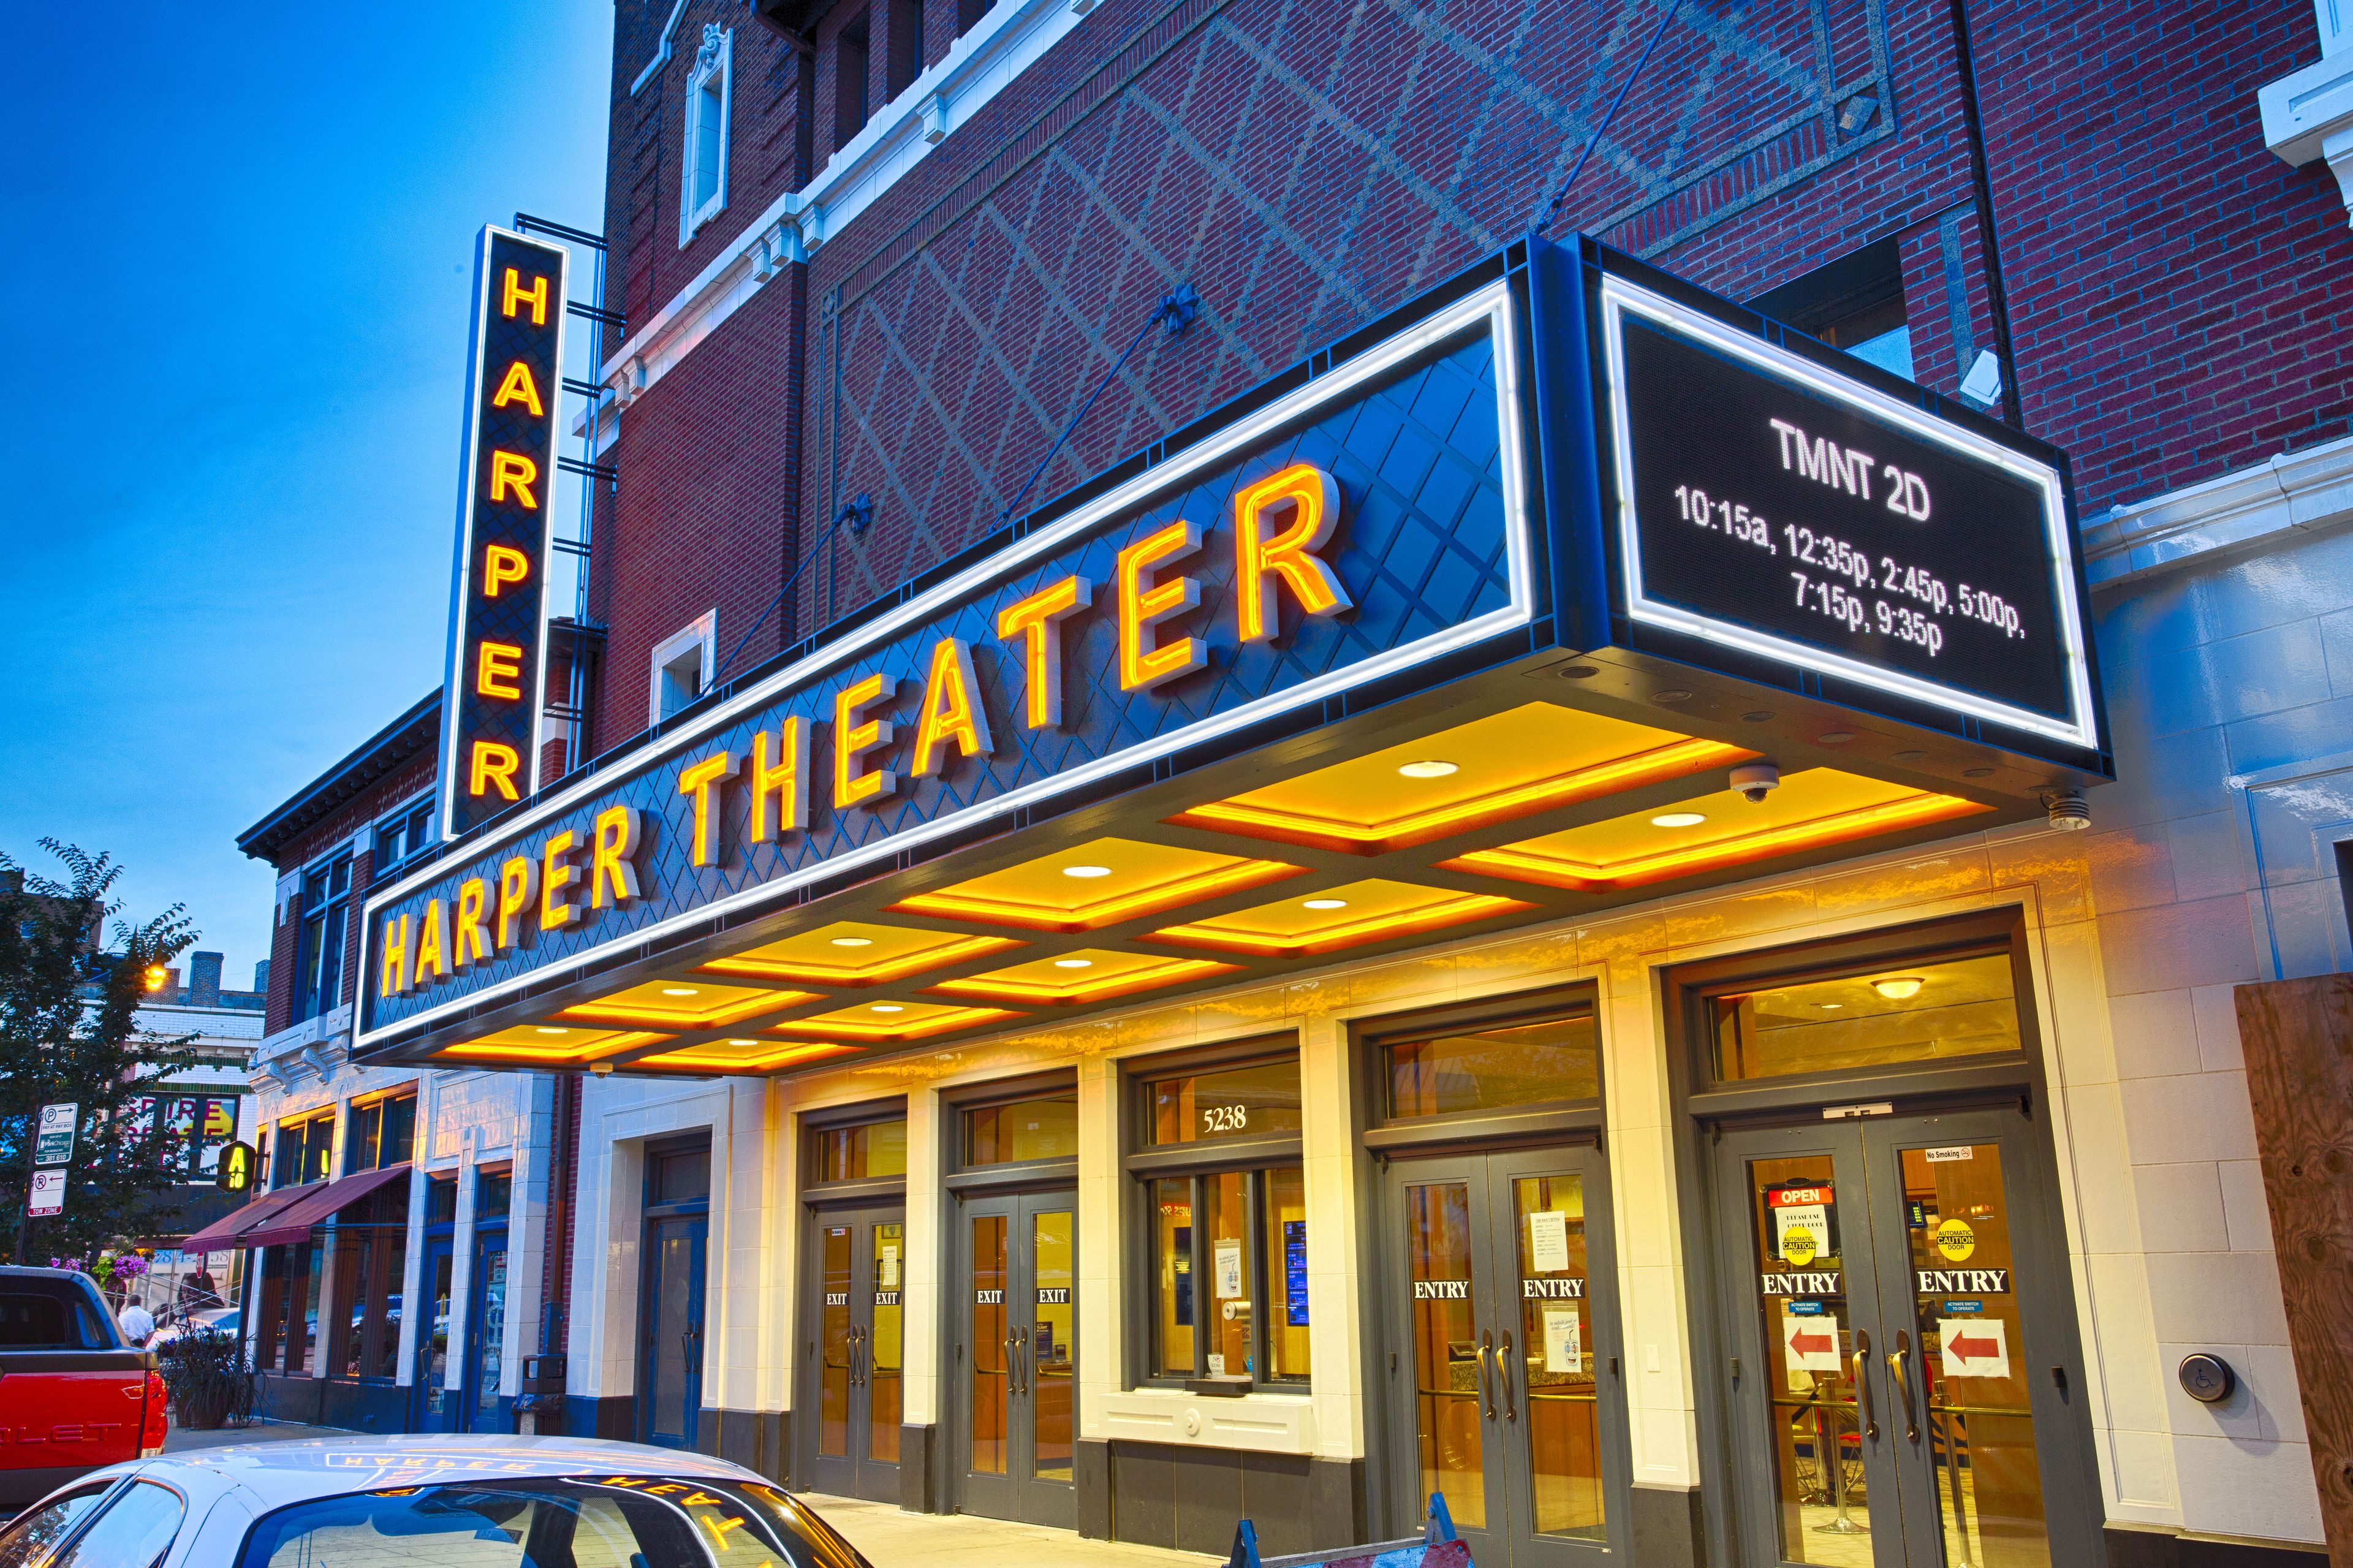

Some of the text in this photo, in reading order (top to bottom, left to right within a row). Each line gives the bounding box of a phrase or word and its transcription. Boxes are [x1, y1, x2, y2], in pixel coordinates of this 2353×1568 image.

[1770, 418, 1931, 522] TMNT 2D
[469, 267, 547, 801] HARPER
[1675, 485, 2026, 639] 10:15a, 12:35p, 2:45p, 5:00p,
[1791, 572, 1943, 657] 7:15p, 9:35p
[382, 805, 640, 998] HARPER
[679, 464, 1354, 868] THEATER
[1204, 1105, 1246, 1133] 5238
[229, 1148, 244, 1172] A
[1927, 1150, 1960, 1160] No Smoking
[1781, 1189, 1820, 1203] OPEN
[1414, 1281, 1469, 1298] ENTRY
[1523, 1279, 1584, 1298] ENTRY
[1762, 1273, 1839, 1294] ENTRY
[1917, 1270, 2006, 1292] ENTRY
[827, 1293, 847, 1305] EXIT
[876, 1292, 897, 1305] EXIT
[977, 1290, 1002, 1303] EXIT
[1039, 1289, 1066, 1303] EXIT
